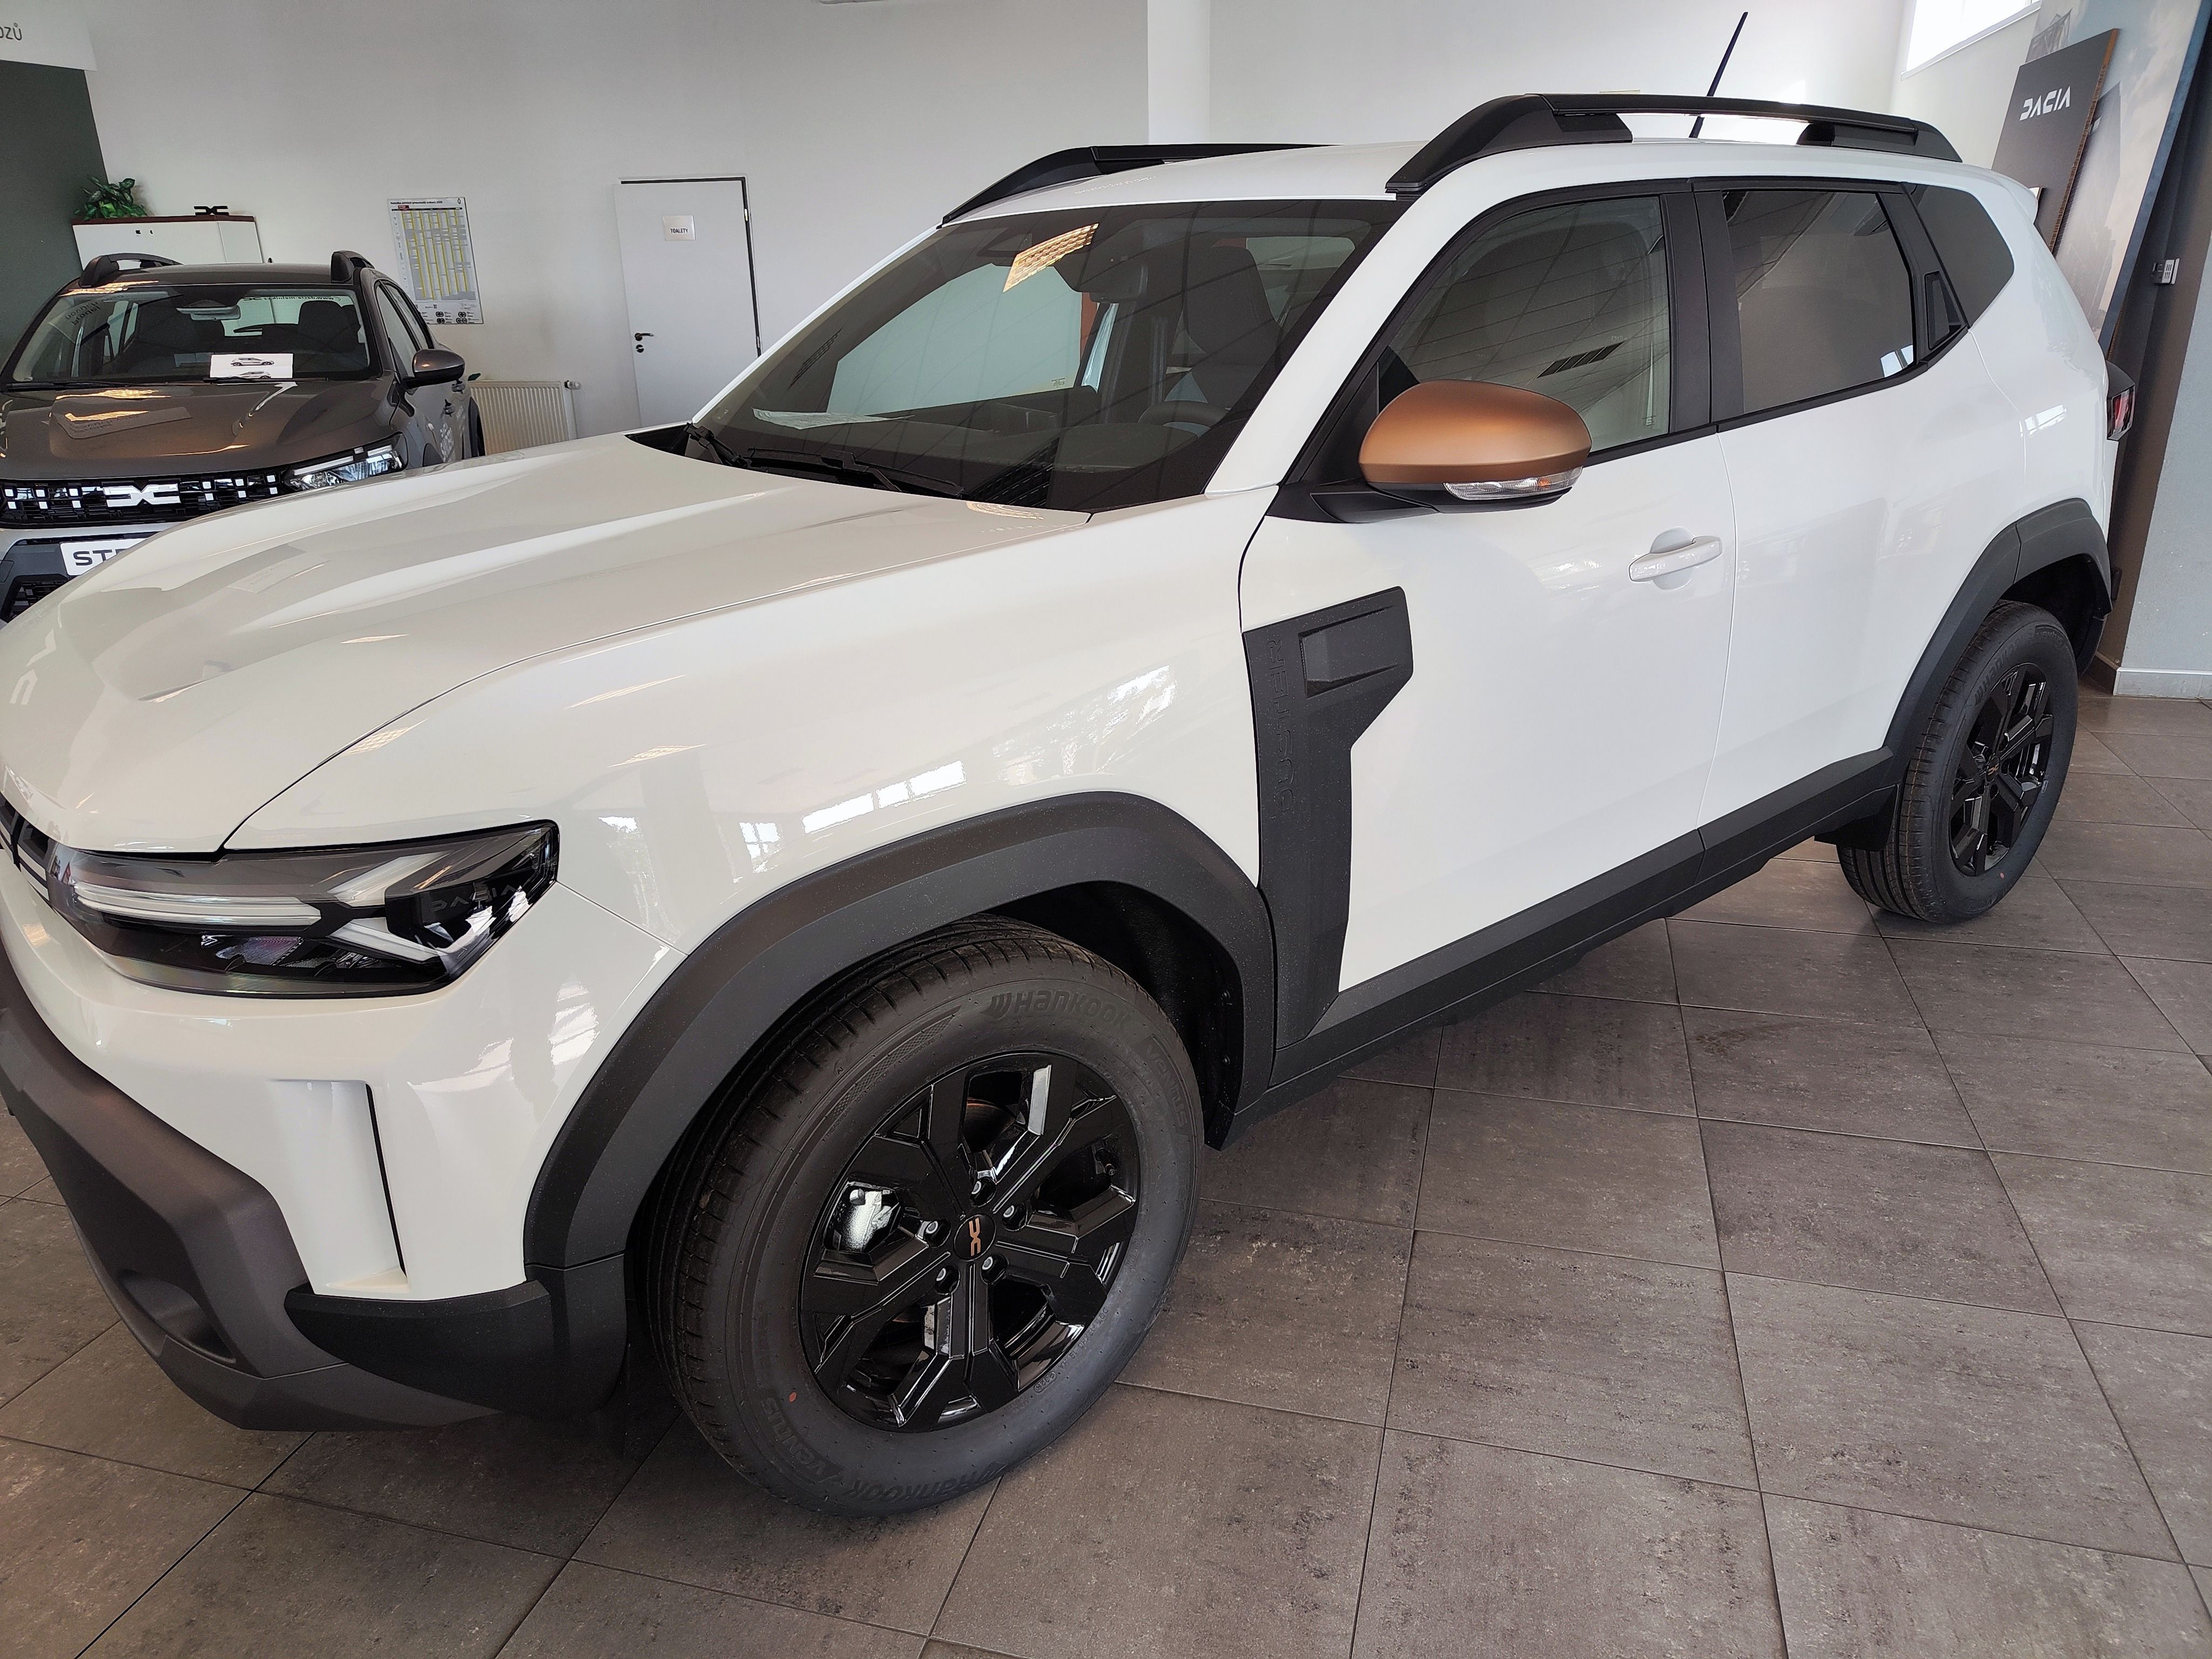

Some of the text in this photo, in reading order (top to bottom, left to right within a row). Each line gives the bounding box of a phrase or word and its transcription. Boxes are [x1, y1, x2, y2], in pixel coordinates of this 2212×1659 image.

[2020, 86, 2071, 121] DACIA
[73, 548, 129, 566] ST
[1267, 638, 1296, 814] DUSTER
